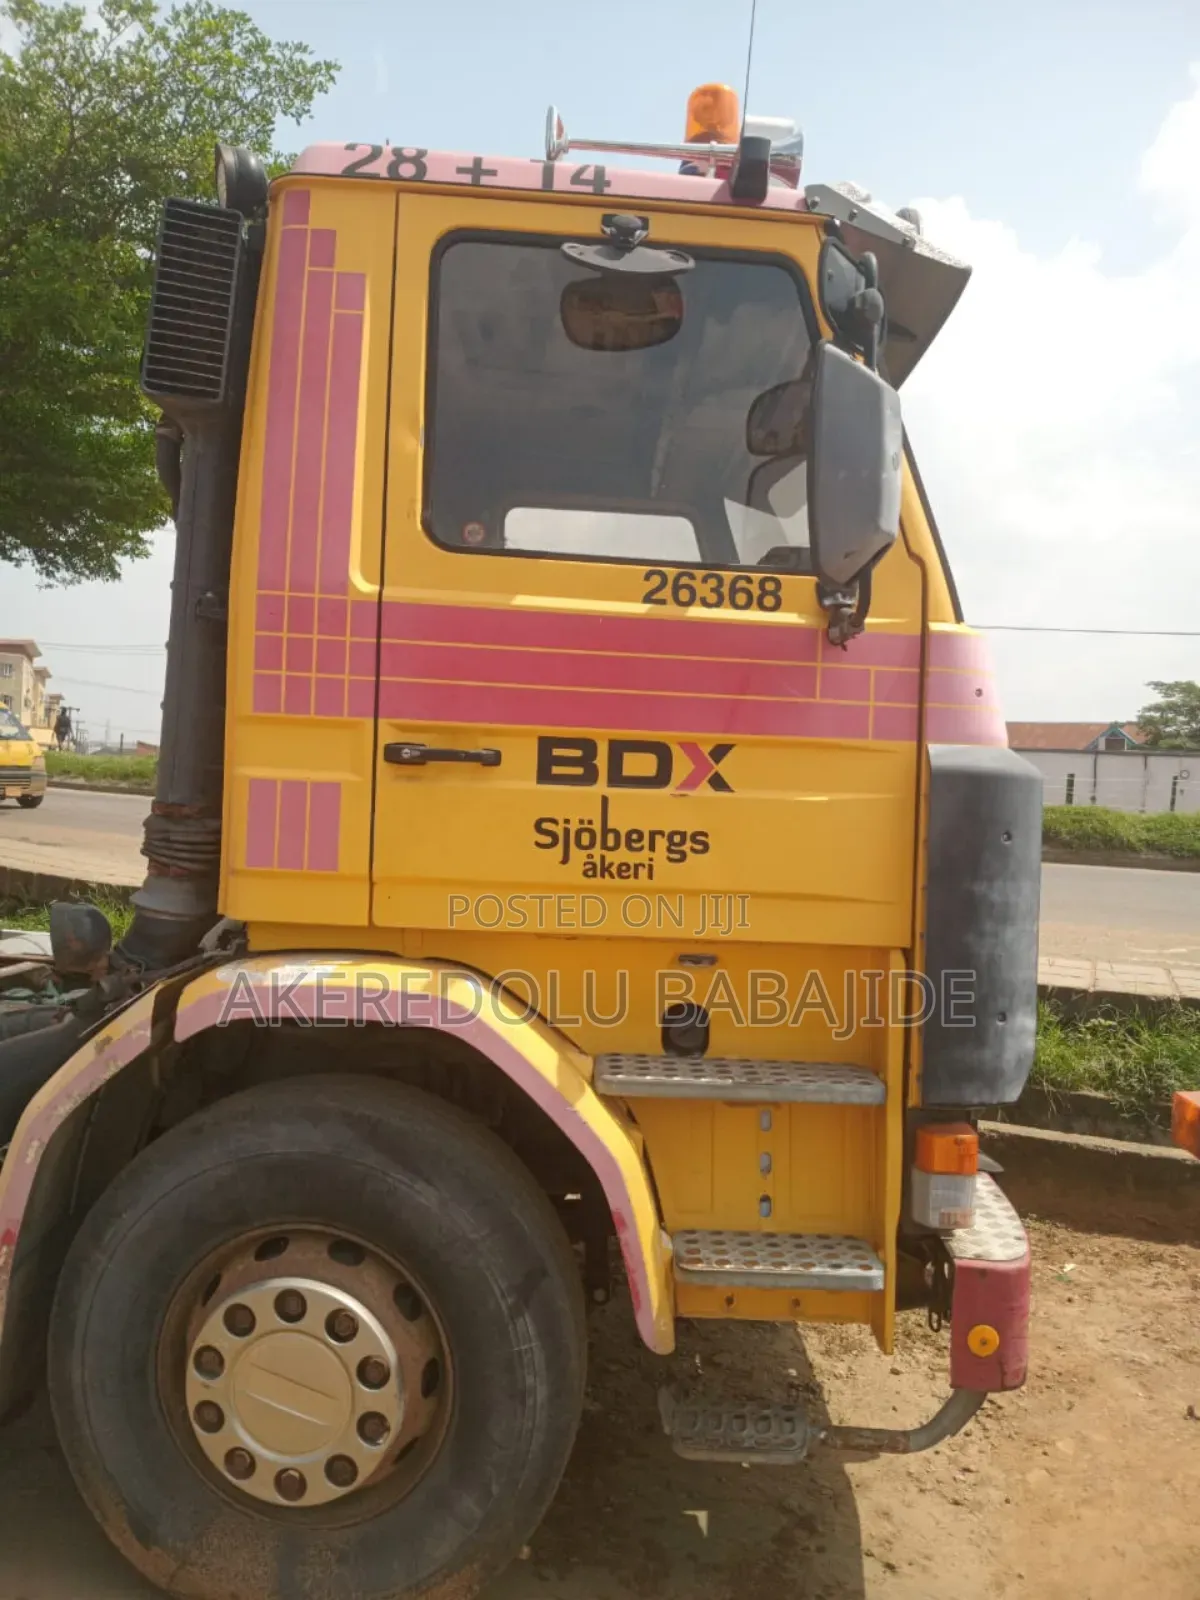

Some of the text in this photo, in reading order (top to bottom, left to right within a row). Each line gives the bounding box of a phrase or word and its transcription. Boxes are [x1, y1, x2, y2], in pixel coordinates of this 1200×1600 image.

[341, 143, 429, 180] 28
[530, 159, 612, 193] 14
[642, 569, 783, 612] 26368
[536, 735, 737, 793] BDX
[533, 795, 710, 865] Sjöbergs
[582, 853, 655, 881] åkeri
